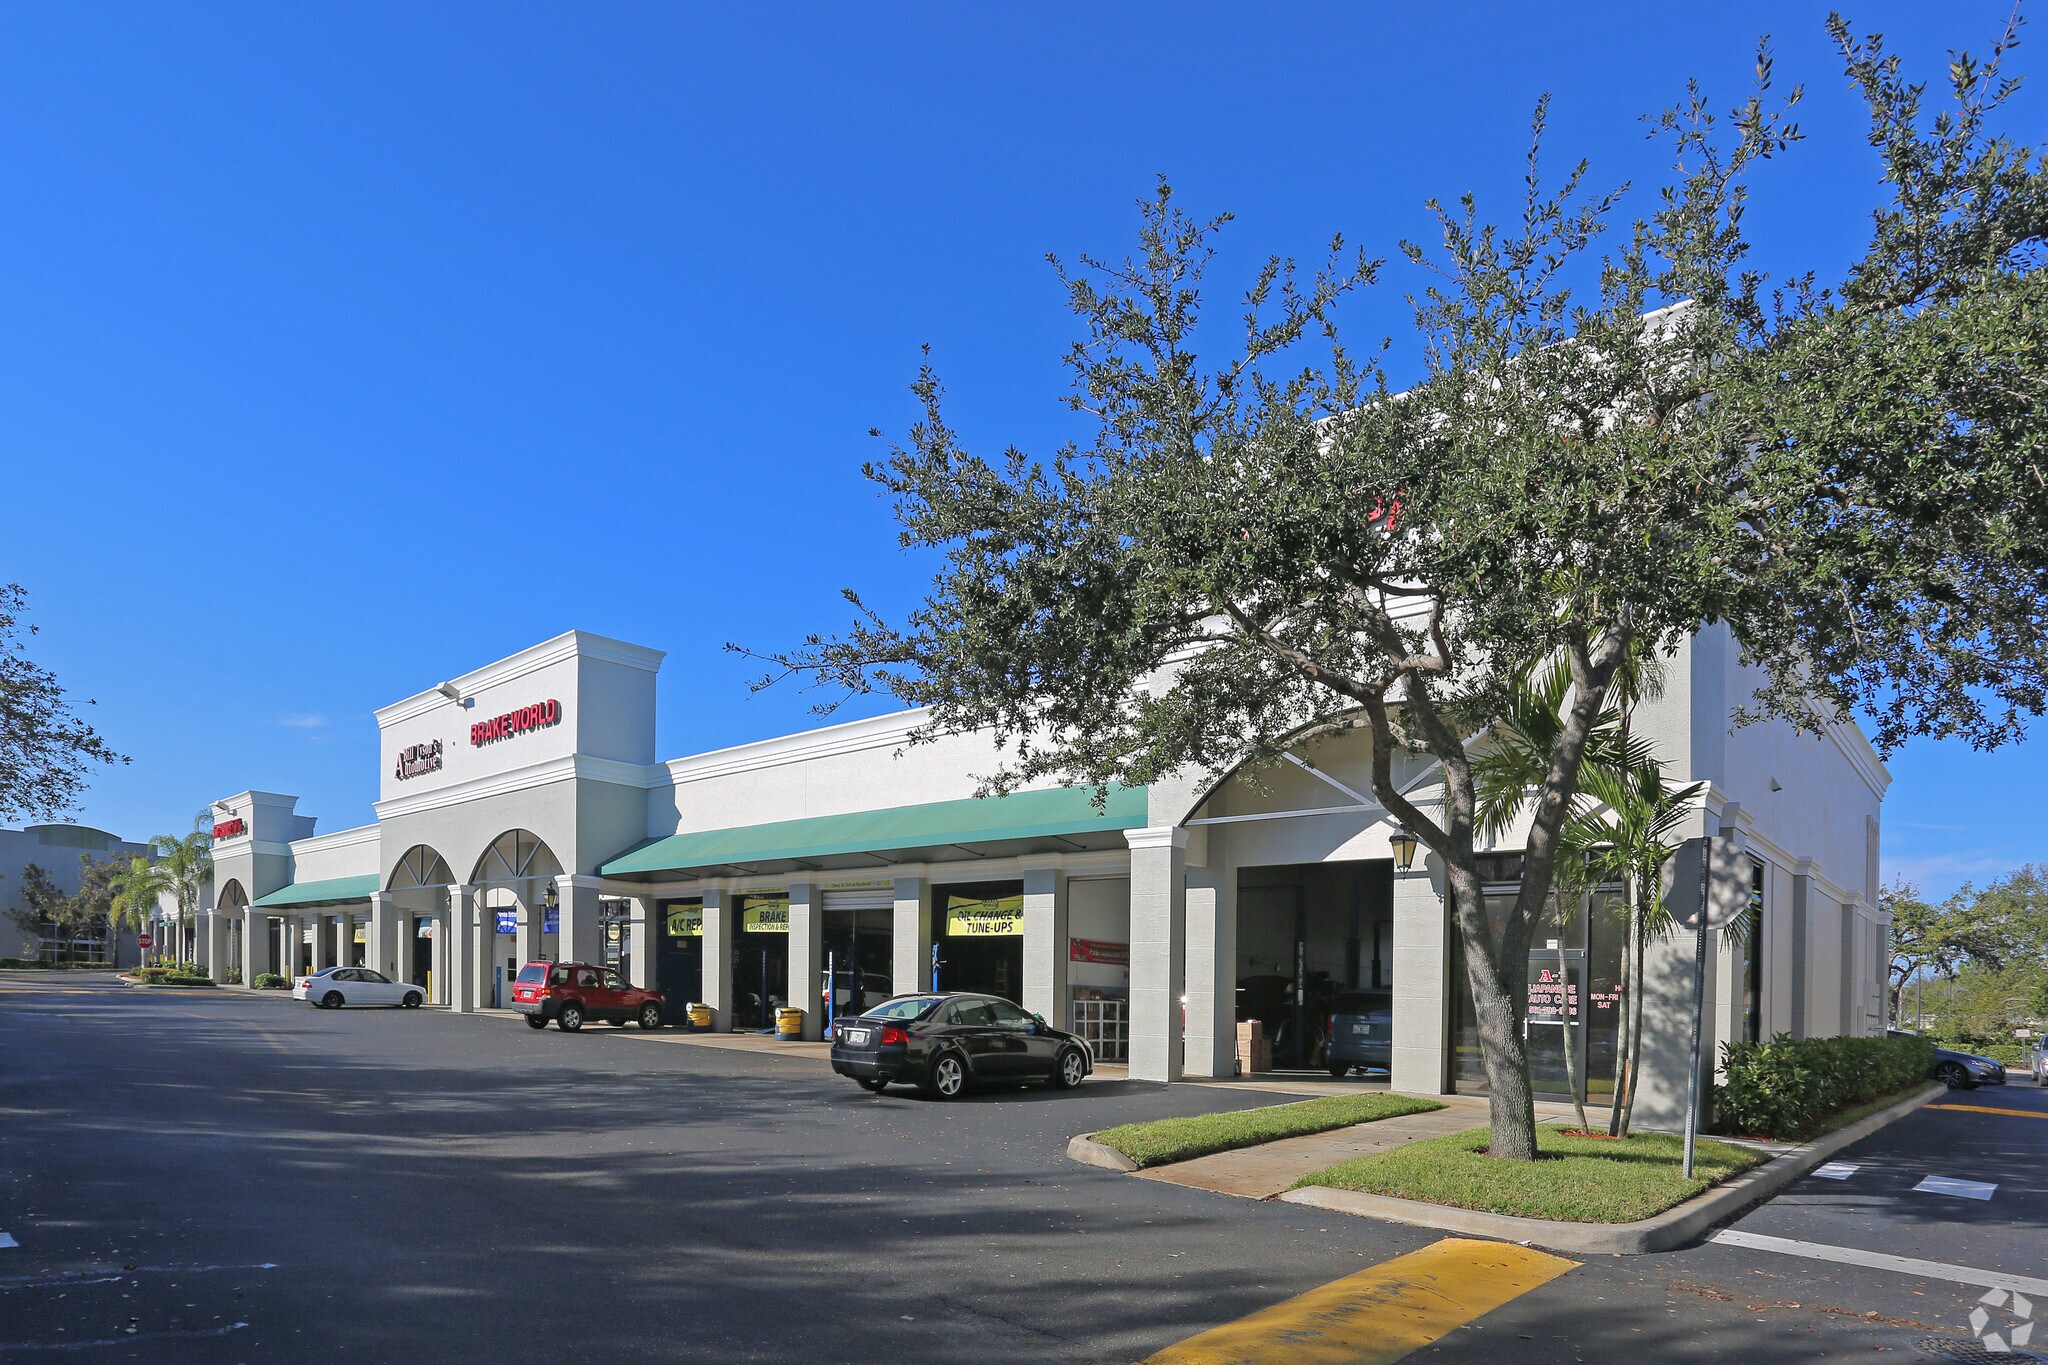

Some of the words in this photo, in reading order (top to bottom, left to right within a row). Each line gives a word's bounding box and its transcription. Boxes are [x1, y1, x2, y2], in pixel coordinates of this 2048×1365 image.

[471, 713, 509, 746] BRAKE
[511, 699, 557, 733] WORLD
[760, 911, 786, 922] BRAKE
[957, 911, 971, 921] OIL
[974, 910, 1013, 921] CHANGE
[1015, 909, 1022, 919] &
[672, 919, 685, 931] A/C
[749, 923, 774, 931] INSPECTION
[967, 922, 1013, 933] TUNE-UPS
[1529, 995, 1552, 1004] AUTO
[1591, 993, 1619, 1001] MON-FRI
